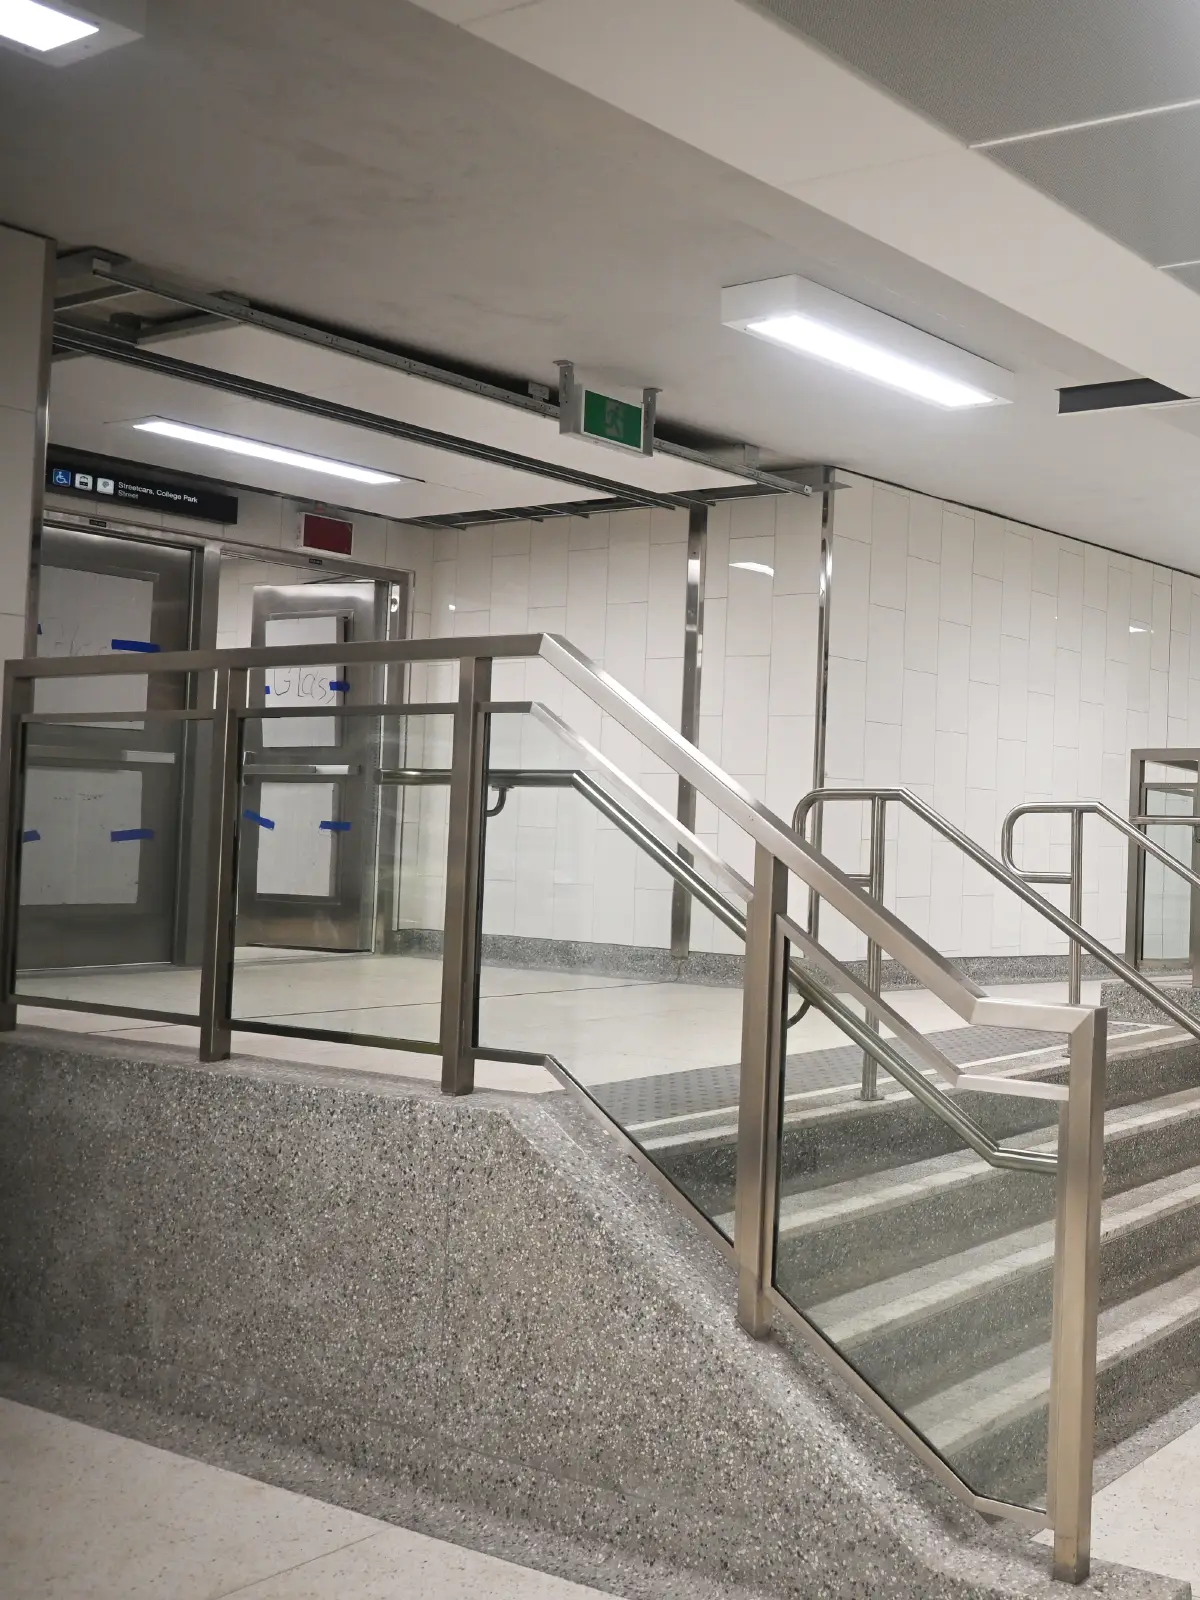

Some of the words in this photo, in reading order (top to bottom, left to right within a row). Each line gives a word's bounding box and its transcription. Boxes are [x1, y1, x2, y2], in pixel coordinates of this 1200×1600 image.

[118, 481, 155, 495] Streetcars,
[156, 489, 182, 501] College
[183, 494, 198, 503] Park
[118, 489, 139, 499] Street
